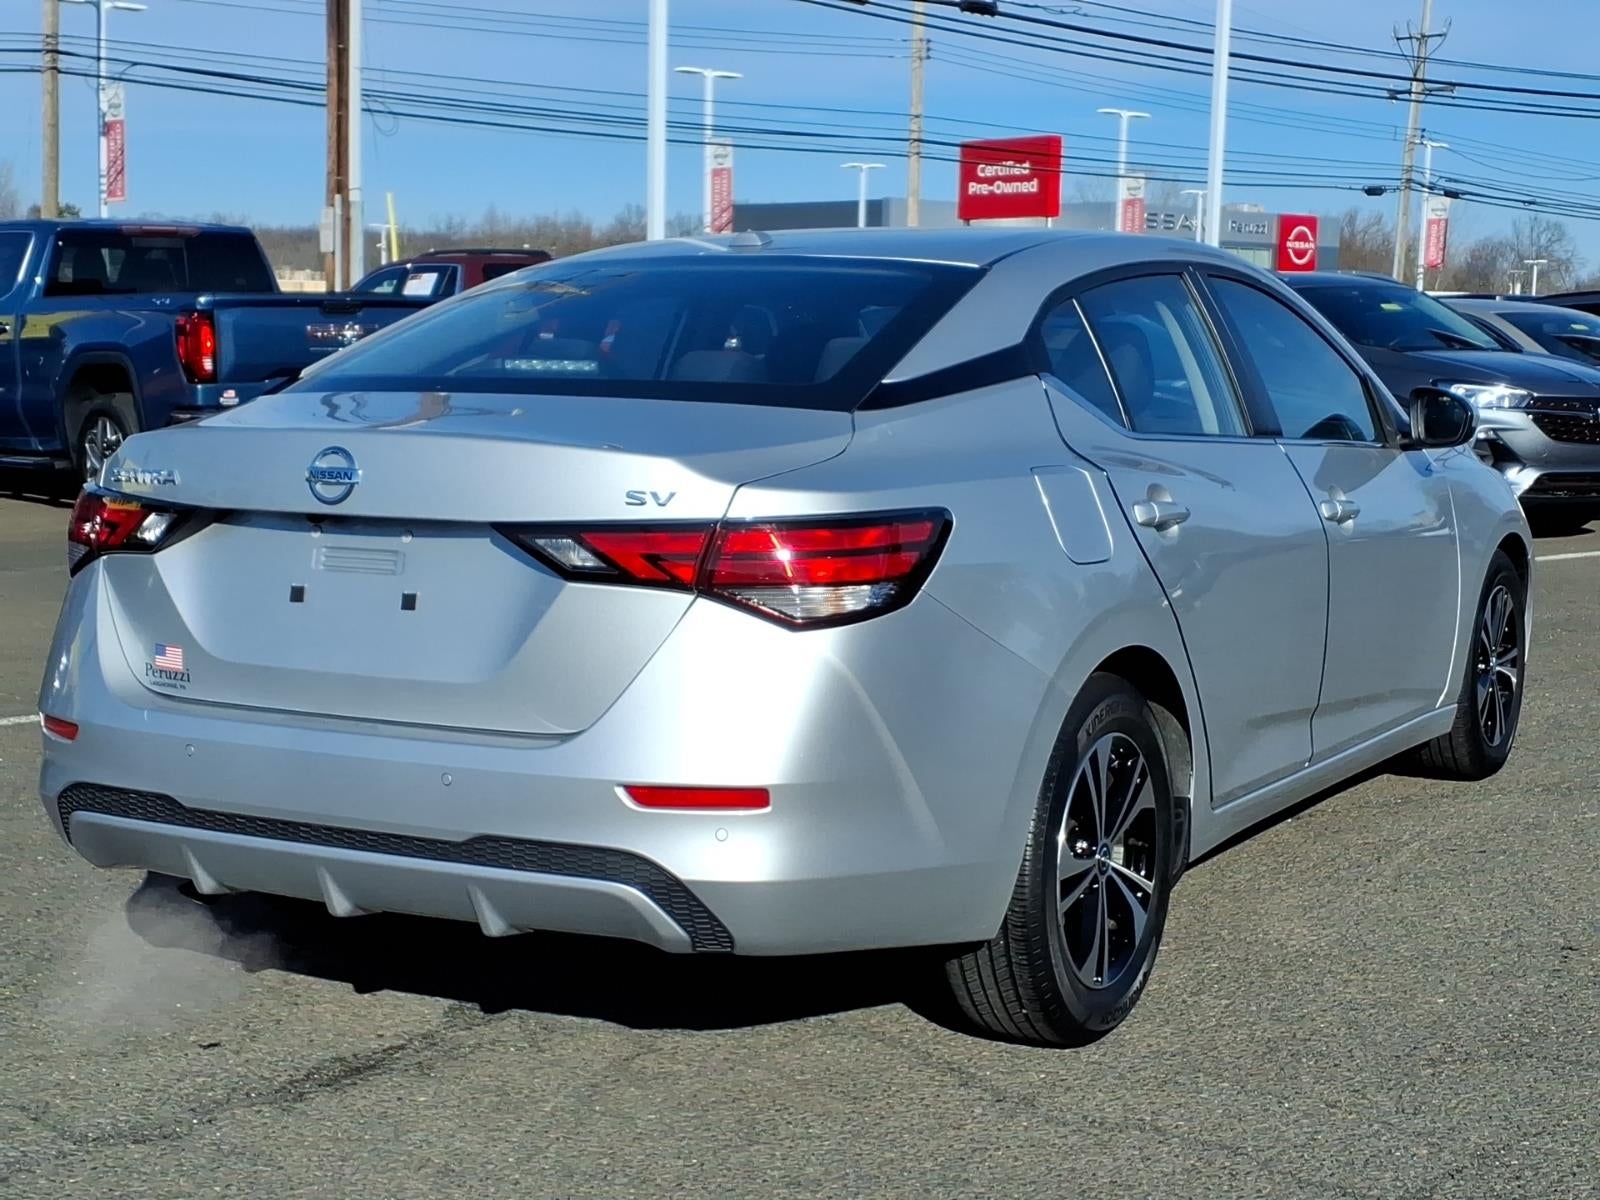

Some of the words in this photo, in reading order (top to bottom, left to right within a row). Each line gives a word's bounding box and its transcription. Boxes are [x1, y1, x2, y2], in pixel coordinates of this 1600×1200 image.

[976, 160, 1031, 177] Certified
[967, 177, 1039, 195] Pre-Owned
[1228, 219, 1268, 235] Peruzzi
[1286, 240, 1315, 250] NISSAN
[310, 469, 353, 481] NISSAN
[625, 489, 677, 507] SV
[145, 661, 191, 683] Peruzzi
